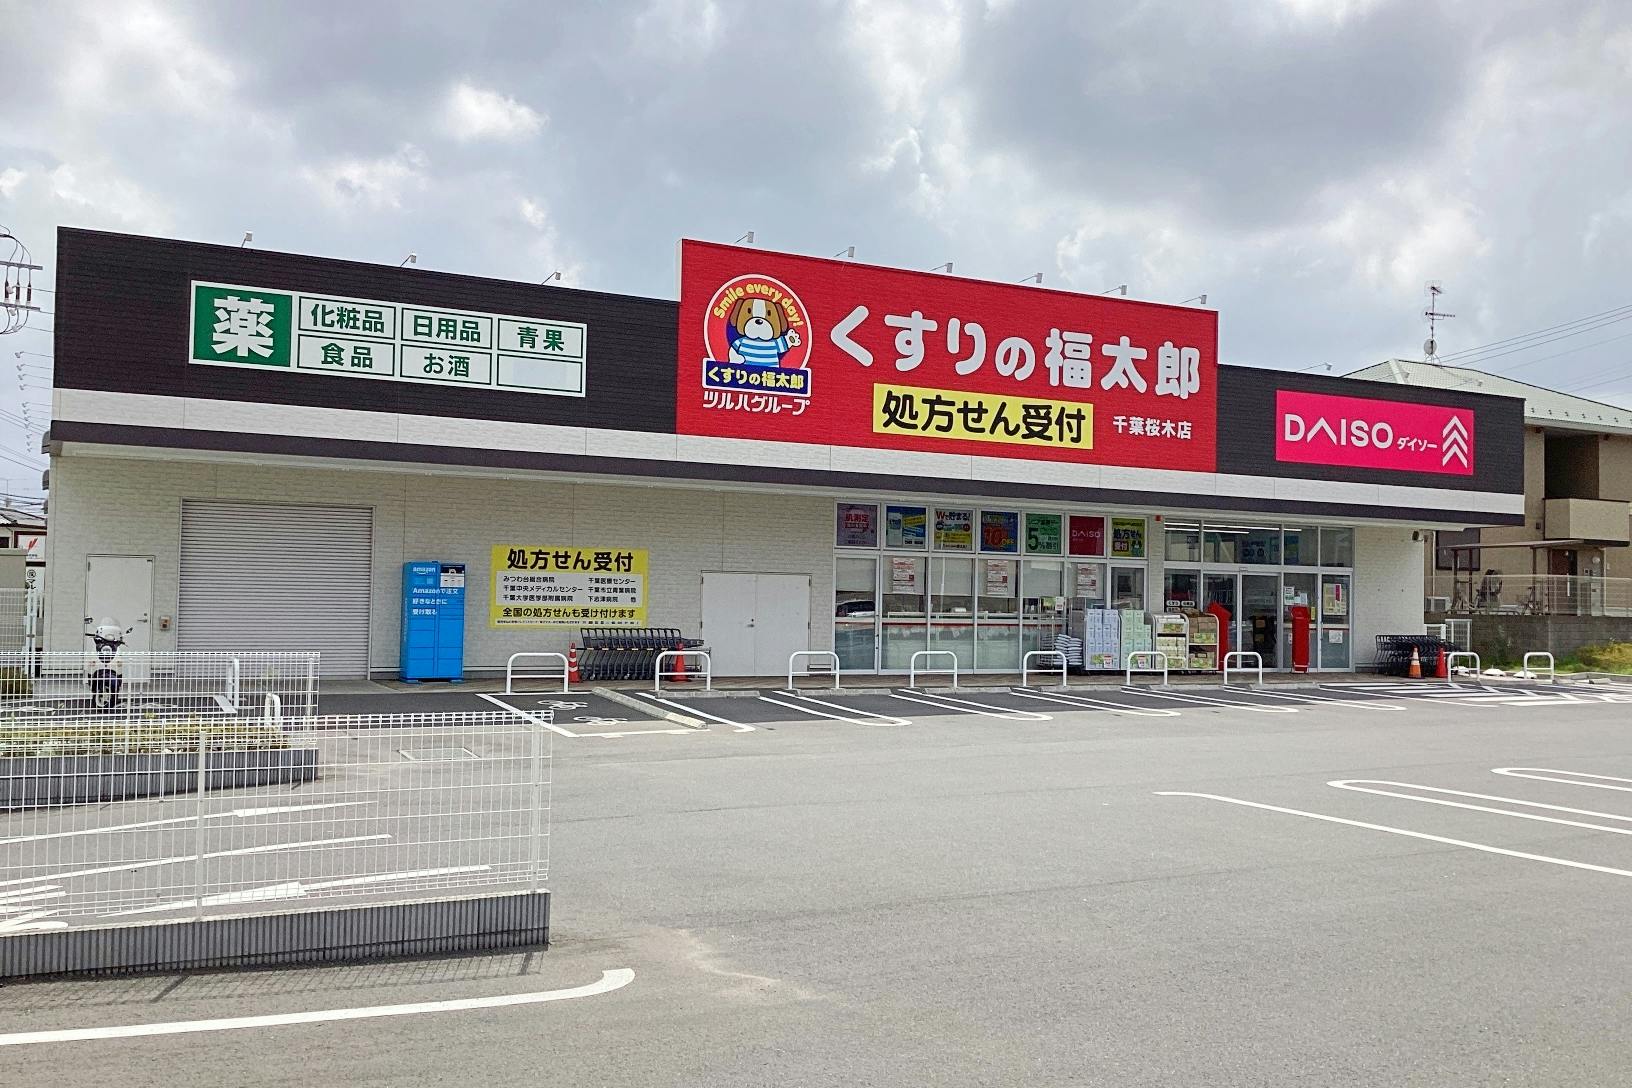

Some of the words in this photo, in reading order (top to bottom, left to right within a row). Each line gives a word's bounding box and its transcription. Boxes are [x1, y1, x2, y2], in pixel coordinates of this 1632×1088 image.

[714, 286, 744, 319] Smile
[746, 284, 782, 303] every
[782, 297, 804, 327] day!
[212, 296, 274, 358] 薬
[310, 304, 385, 334] 化粧品
[413, 315, 481, 343] 日用品
[517, 326, 565, 352] 青果
[320, 343, 373, 369] 食品
[423, 353, 470, 378] お酒
[830, 305, 1202, 400] くすりの福太郎
[707, 366, 804, 390] くすりの福太郎
[702, 390, 810, 416] ツルハグループ
[881, 392, 1087, 443] 処方せん受付
[1111, 415, 1192, 440] 千葉桜木店
[1284, 413, 1394, 449] DAISO
[1397, 436, 1438, 452] ダイソー
[1072, 530, 1101, 538] DAISO
[507, 548, 633, 573] 処方せん受付
[502, 607, 636, 619] 全国の処方せんも受け付けます
